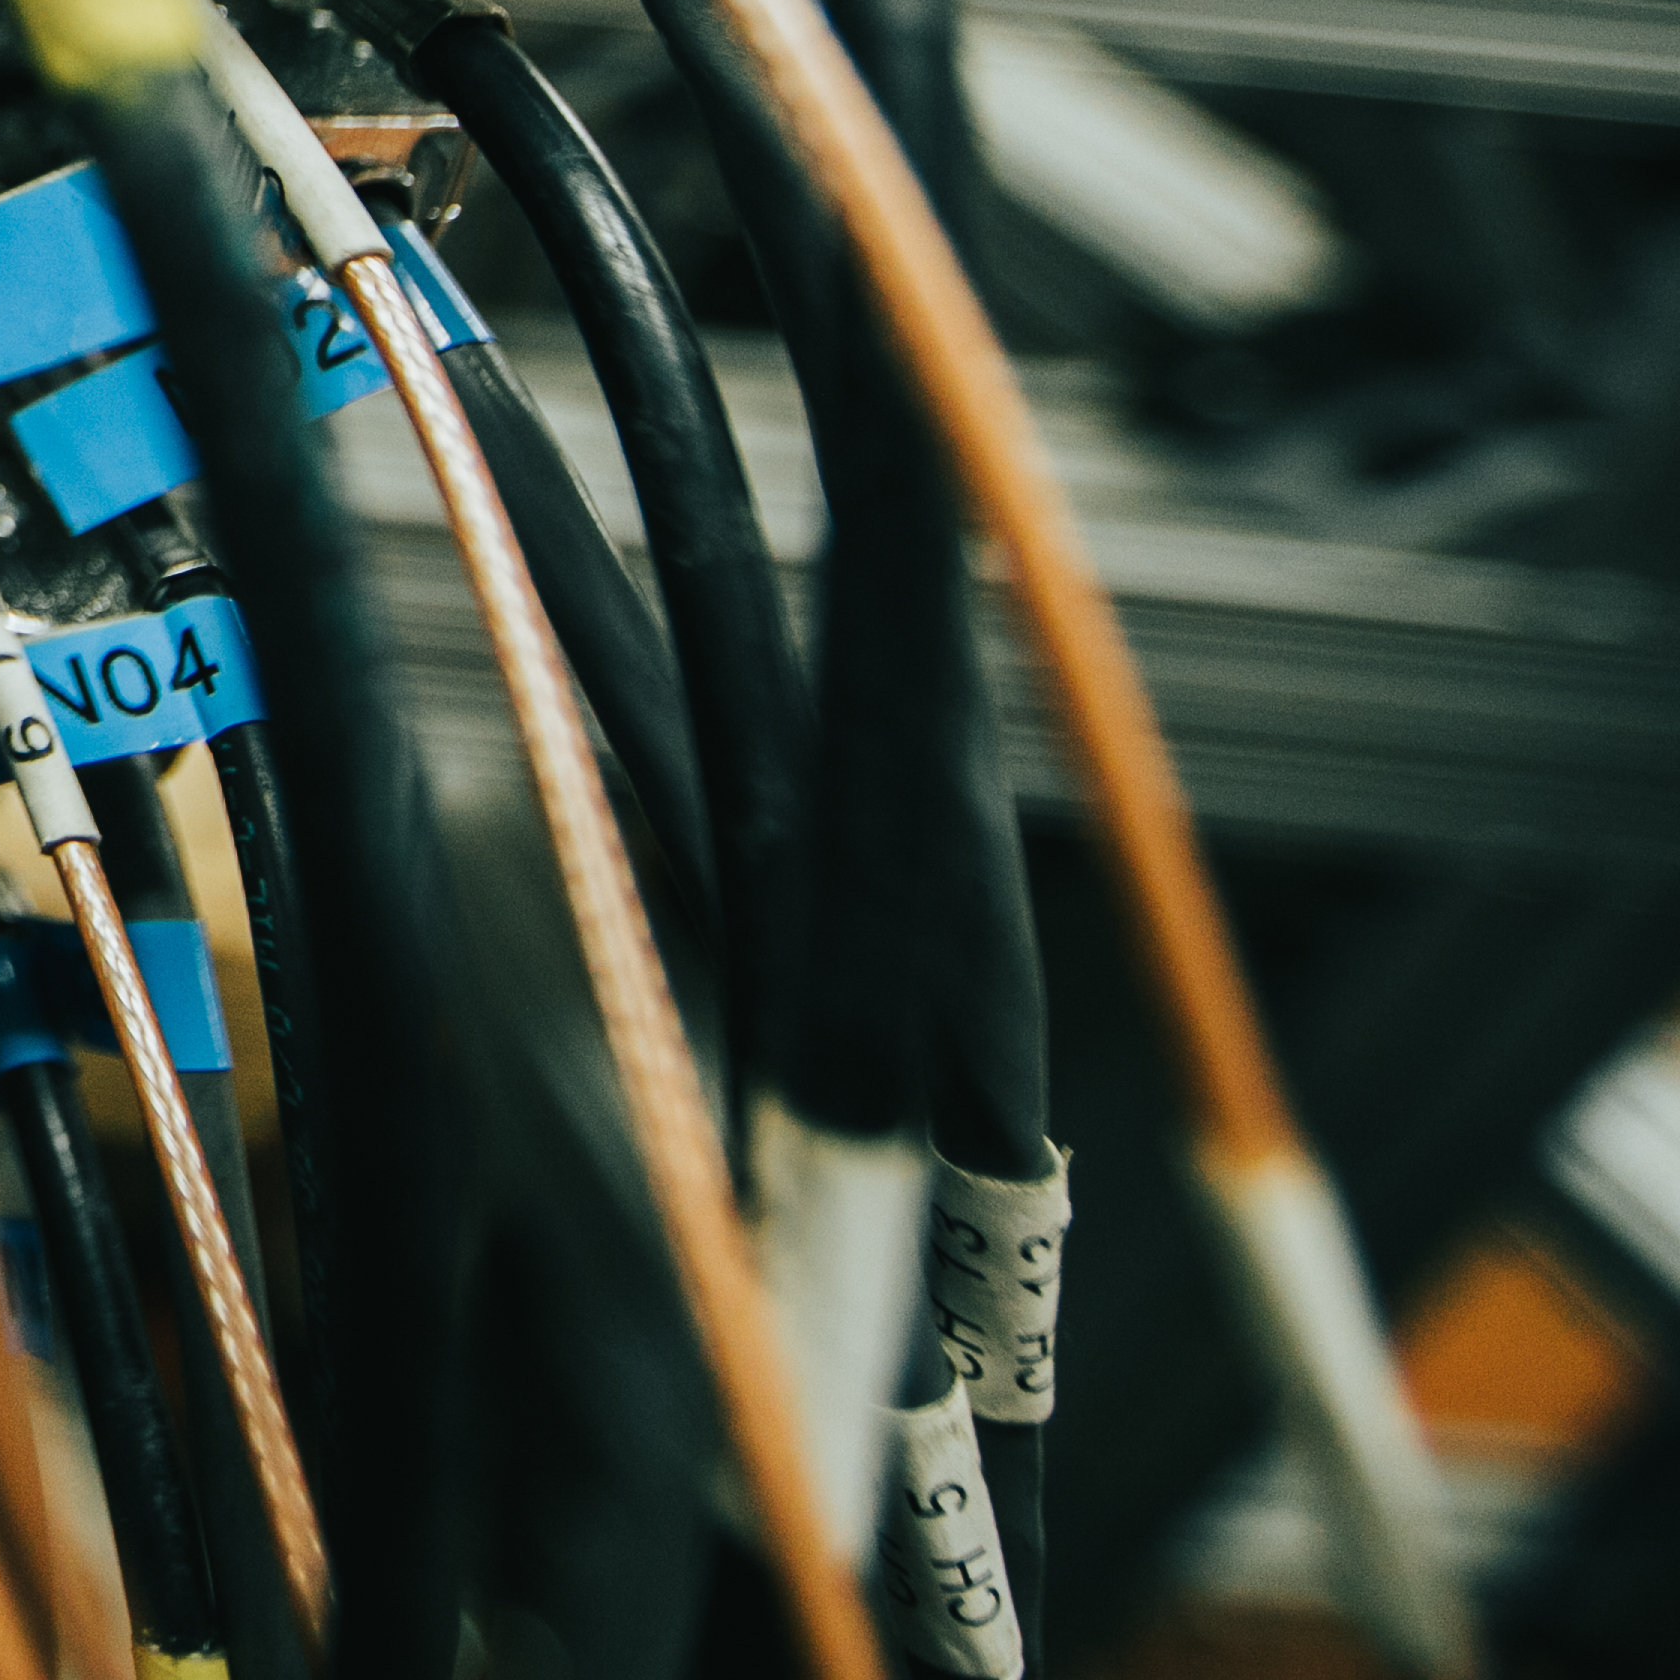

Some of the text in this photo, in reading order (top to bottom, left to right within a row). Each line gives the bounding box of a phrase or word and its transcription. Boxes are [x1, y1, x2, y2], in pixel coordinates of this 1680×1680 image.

[32, 625, 220, 724] N04
[904, 1482, 1001, 1628] CH 5
